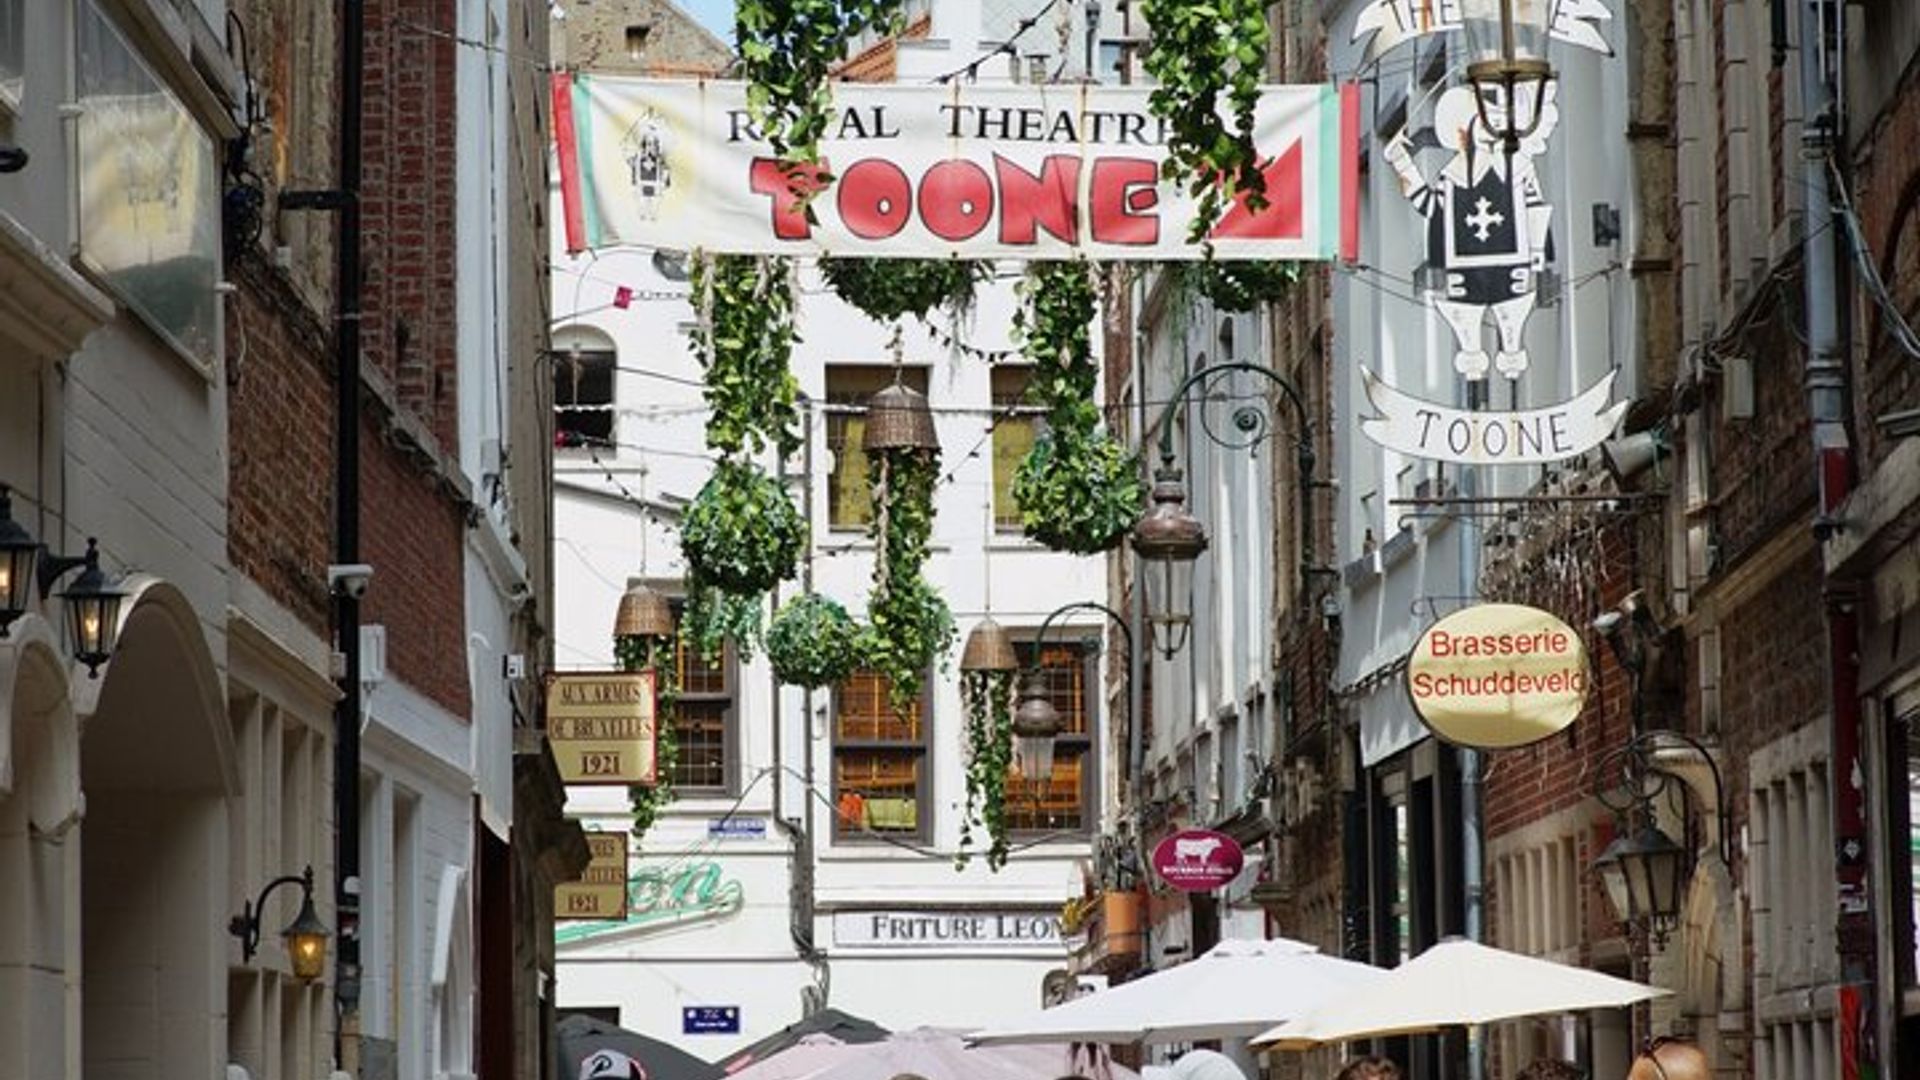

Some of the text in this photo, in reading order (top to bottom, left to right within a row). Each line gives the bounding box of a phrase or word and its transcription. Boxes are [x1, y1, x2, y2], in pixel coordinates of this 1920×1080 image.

[750, 153, 1159, 247] TOONE
[1416, 409, 1573, 457] TOONE
[1431, 628, 1568, 657] Brasserie
[1413, 668, 1585, 699] Schuddeveld
[582, 753, 619, 775] 1921
[871, 914, 986, 940] FRITURE
